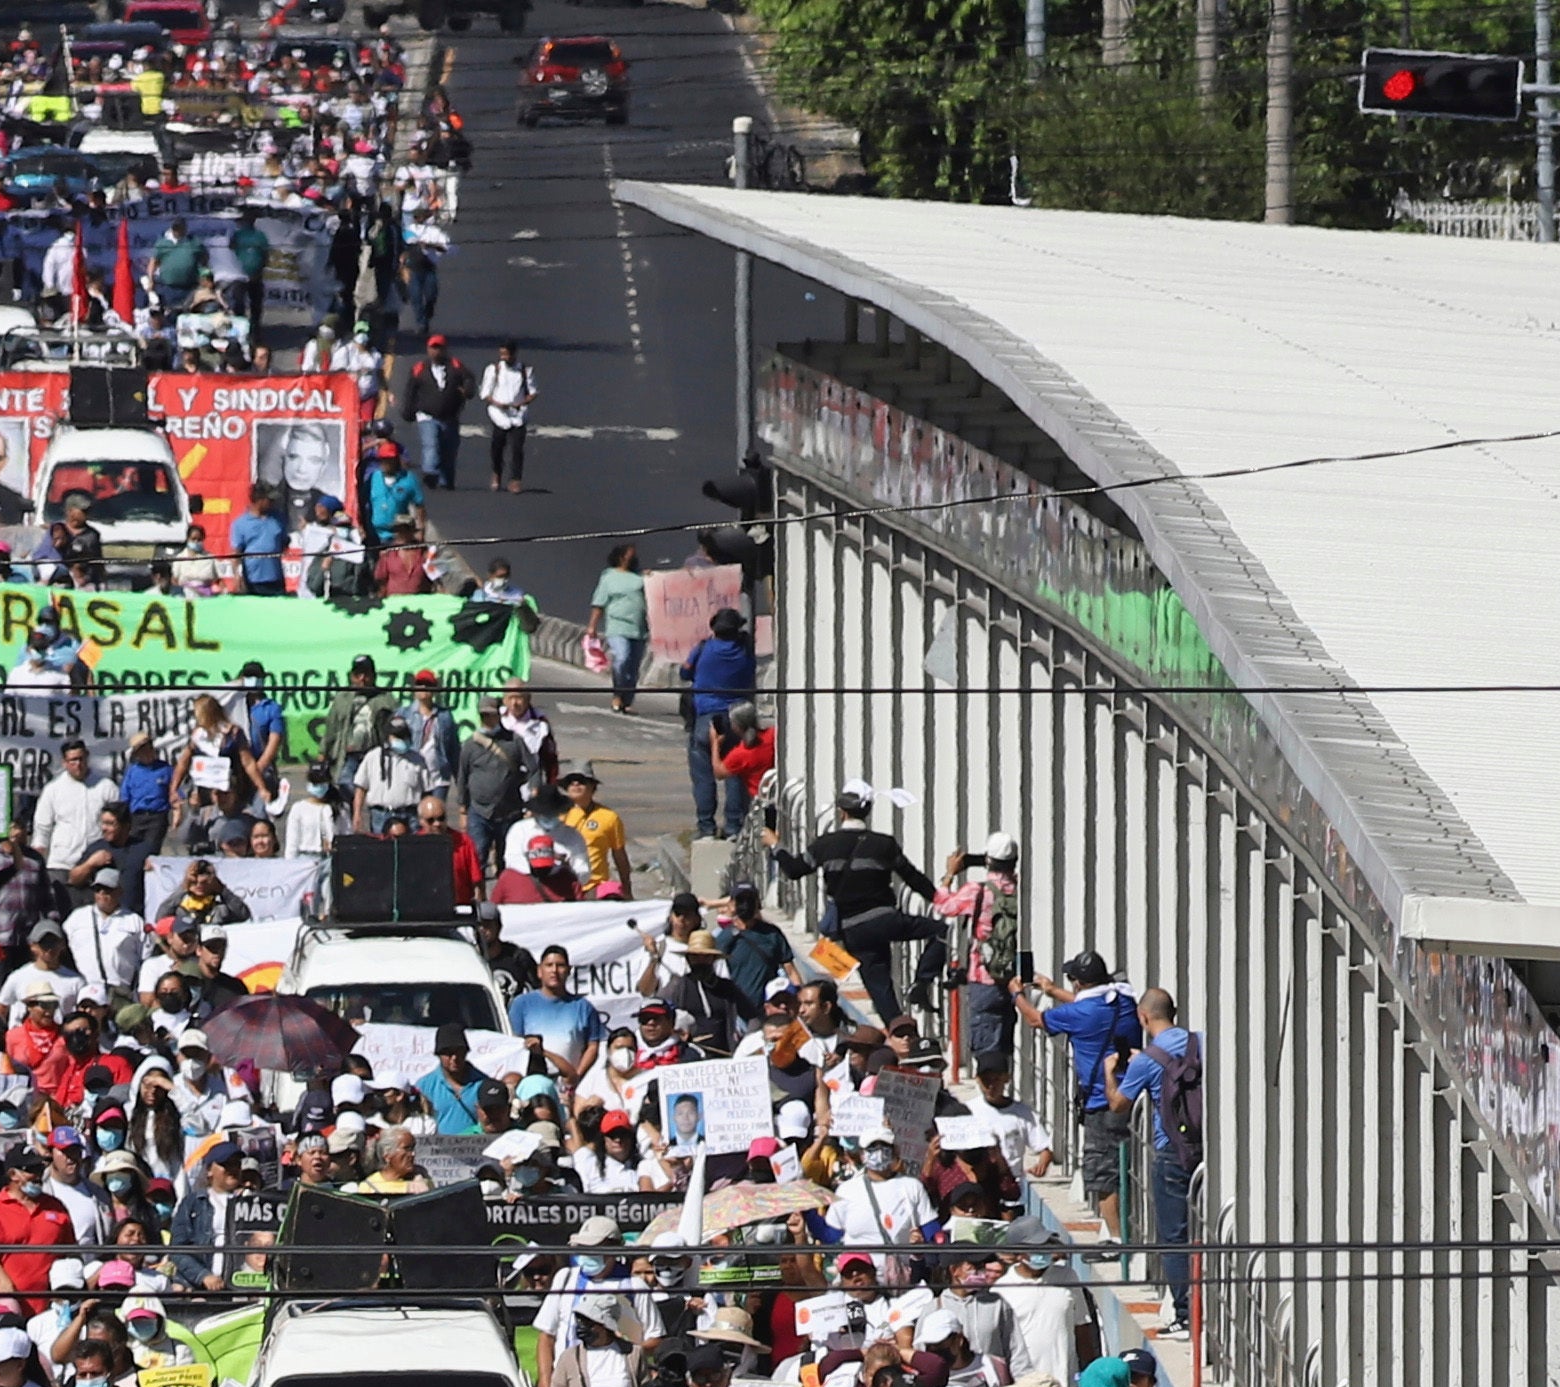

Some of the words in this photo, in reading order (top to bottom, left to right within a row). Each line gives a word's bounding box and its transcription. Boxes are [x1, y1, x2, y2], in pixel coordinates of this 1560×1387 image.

[177, 387, 199, 411] Y
[213, 388, 342, 413] SINDICAL
[48, 699, 81, 738] ES
[93, 697, 126, 738] LA
[234, 1197, 273, 1222] MÁS
[565, 1206, 600, 1223] DEL
